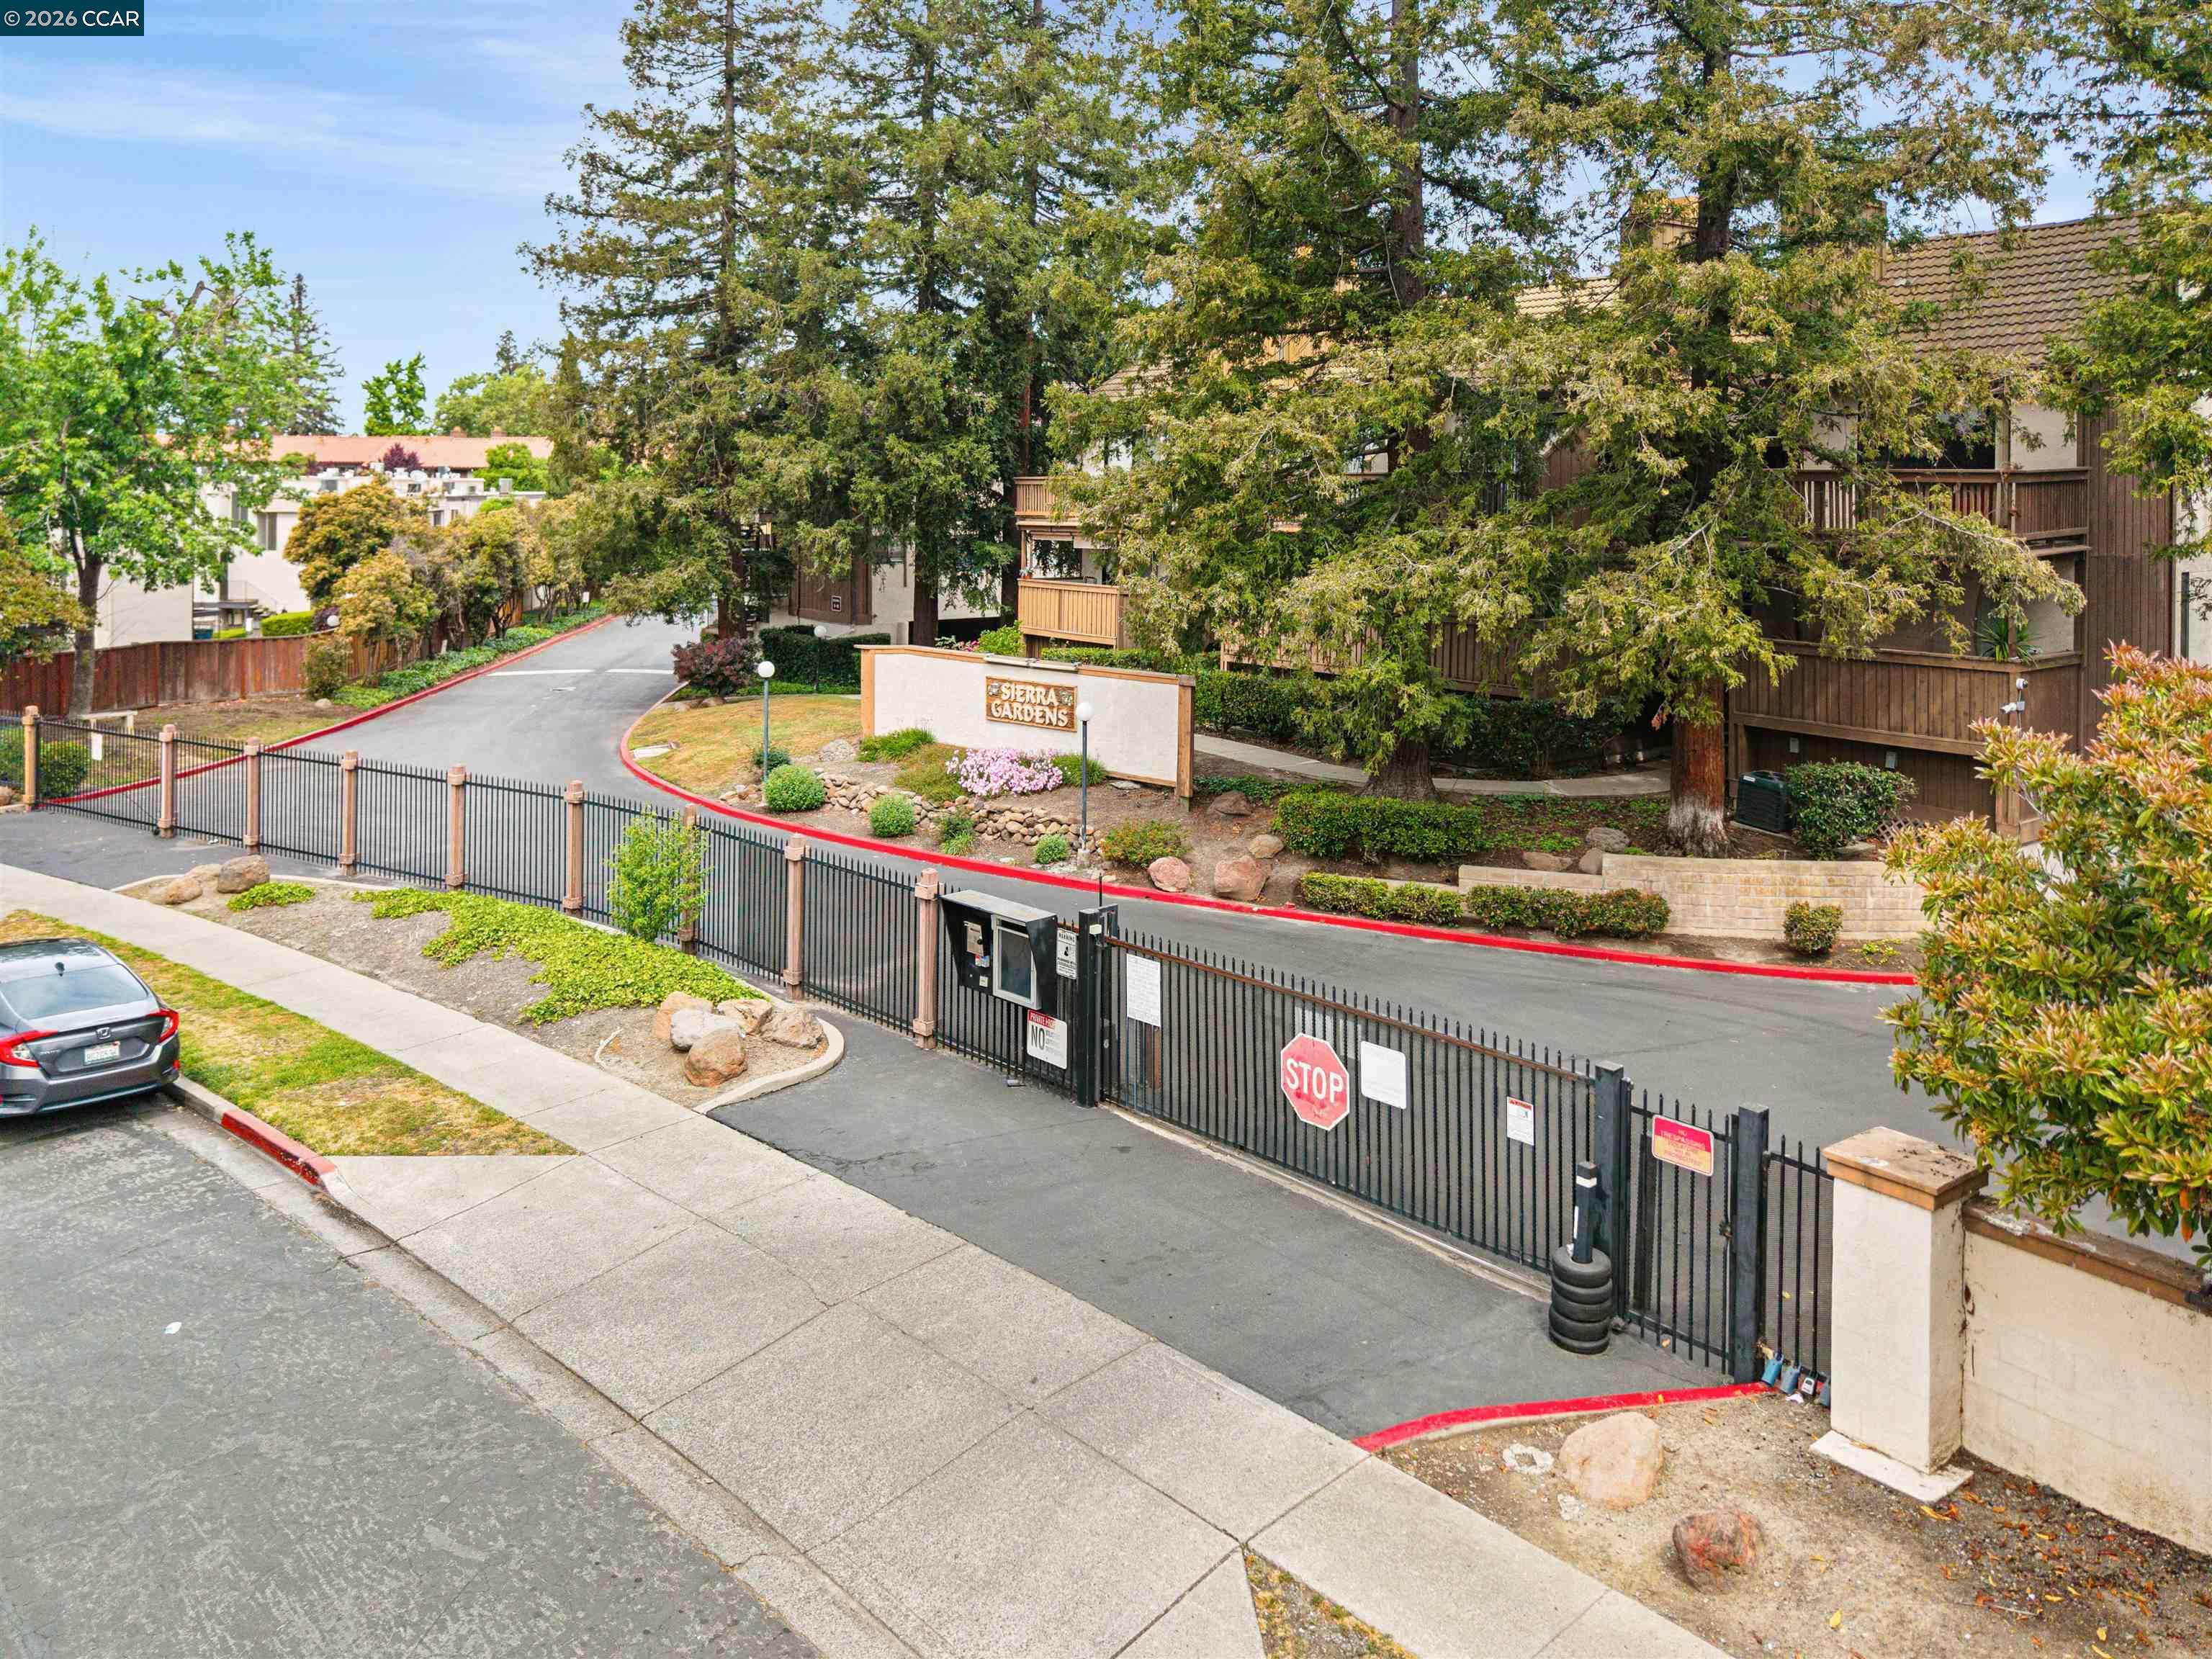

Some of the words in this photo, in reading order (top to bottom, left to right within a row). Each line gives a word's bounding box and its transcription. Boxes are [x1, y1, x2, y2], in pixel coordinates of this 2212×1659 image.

[1001, 682, 1059, 706] SIERRA
[991, 699, 1069, 727] GARDENS
[1031, 1025, 1045, 1050] NO
[1285, 1058, 1344, 1103] STOP
